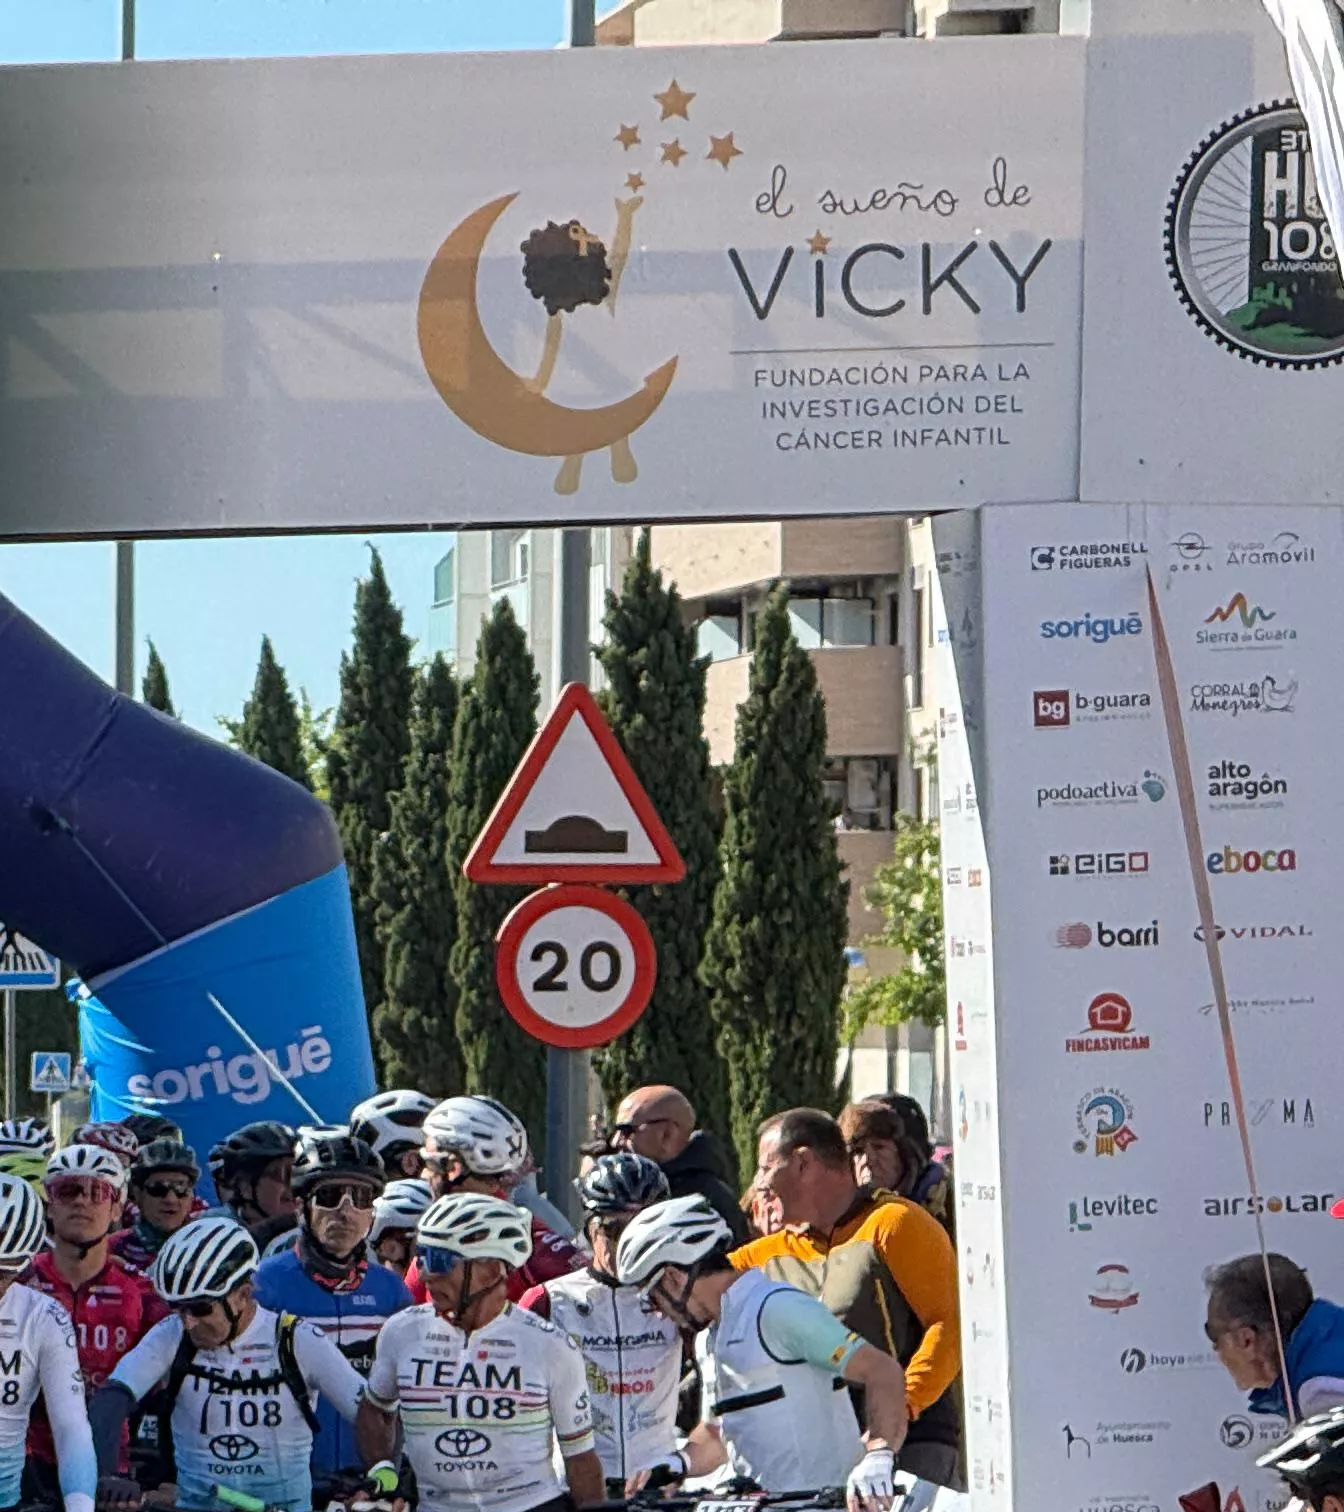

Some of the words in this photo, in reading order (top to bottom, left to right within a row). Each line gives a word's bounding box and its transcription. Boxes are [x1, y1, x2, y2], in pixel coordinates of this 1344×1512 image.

[755, 165, 795, 216] el
[818, 183, 959, 216] sueño
[984, 156, 1032, 207] de
[1261, 261, 1338, 273] GRANFONDO
[754, 361, 908, 388] FUNDACIÓN
[918, 364, 989, 385] PARA
[998, 362, 1031, 383] LA
[761, 394, 965, 420] INVESTIGACIÓN
[974, 395, 1023, 414] DEL
[776, 426, 883, 452] CÁNCER
[893, 425, 1010, 448] INFANTIL
[1059, 543, 1149, 557] CARBONELL
[1060, 556, 1132, 570] FIGUERAS
[1196, 629, 1239, 644] Sierra
[1254, 628, 1297, 642] Guara
[1191, 682, 1246, 698] CORRAL
[1038, 697, 1066, 721] bg
[1208, 759, 1251, 780] alto
[1037, 778, 1138, 808] podoactiva
[1206, 845, 1297, 874] eboca
[1097, 919, 1159, 947] barri
[1230, 925, 1313, 939] VIDAL
[530, 940, 624, 992] 20
[1084, 1196, 1158, 1217] levitec
[77, 1322, 127, 1349] 108
[1150, 1353, 1185, 1367] hoya
[411, 1358, 522, 1391] TEAM
[220, 1400, 282, 1427] 108
[443, 1393, 516, 1420] 108
[1113, 1433, 1154, 1443] Huesca
[208, 1463, 265, 1475] TOYOTA
[435, 1461, 498, 1473] TOYOTA
